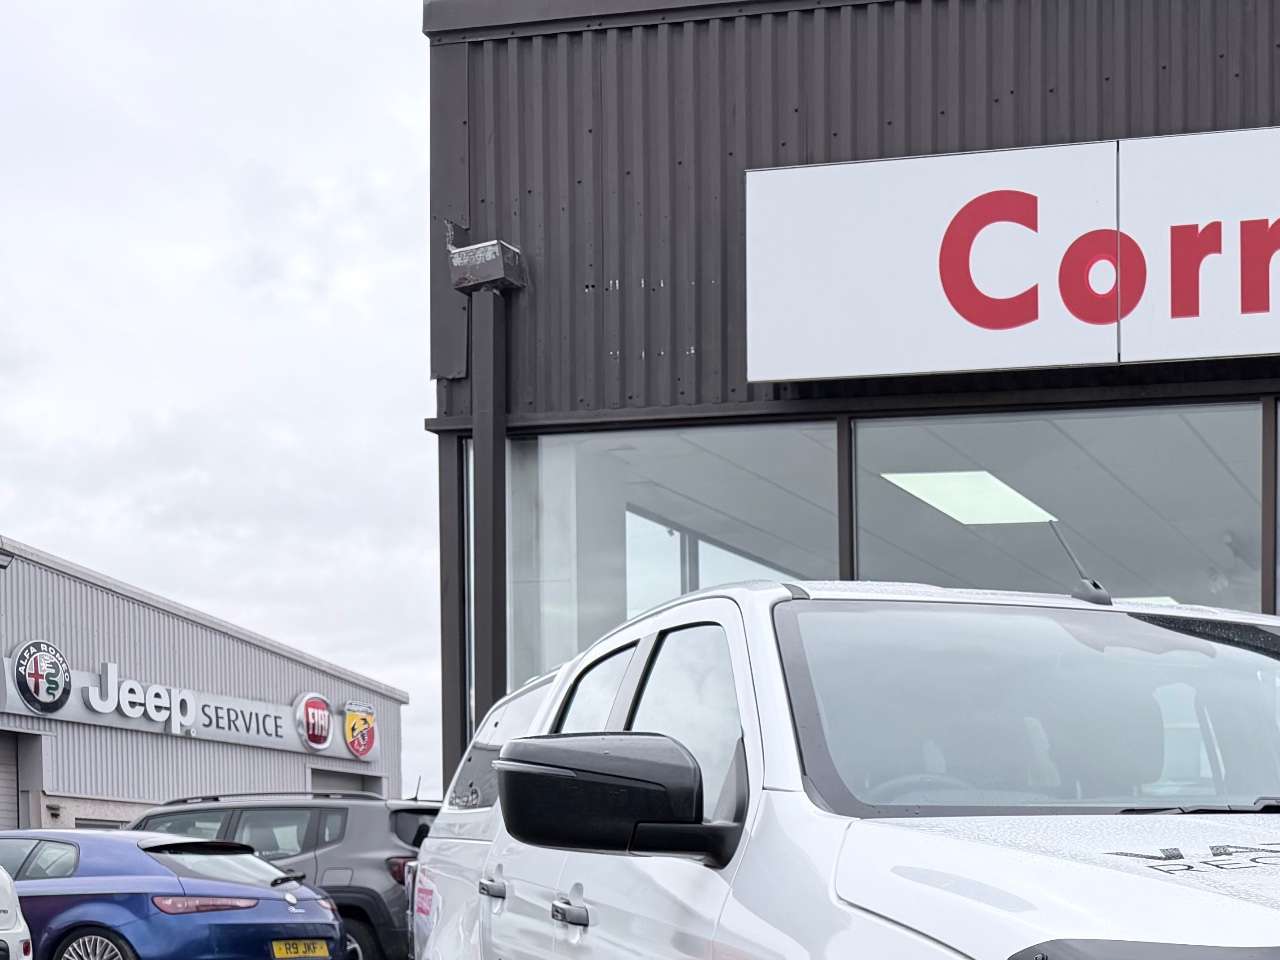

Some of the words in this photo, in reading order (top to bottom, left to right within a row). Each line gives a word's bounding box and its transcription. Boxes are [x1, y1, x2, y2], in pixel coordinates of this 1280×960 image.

[18, 645, 38, 676] ALFA
[40, 643, 70, 682] ROMEO
[84, 662, 197, 735] Jeep
[201, 703, 284, 740] SERVICE
[307, 706, 330, 737] FIAT
[284, 942, 299, 955] R9
